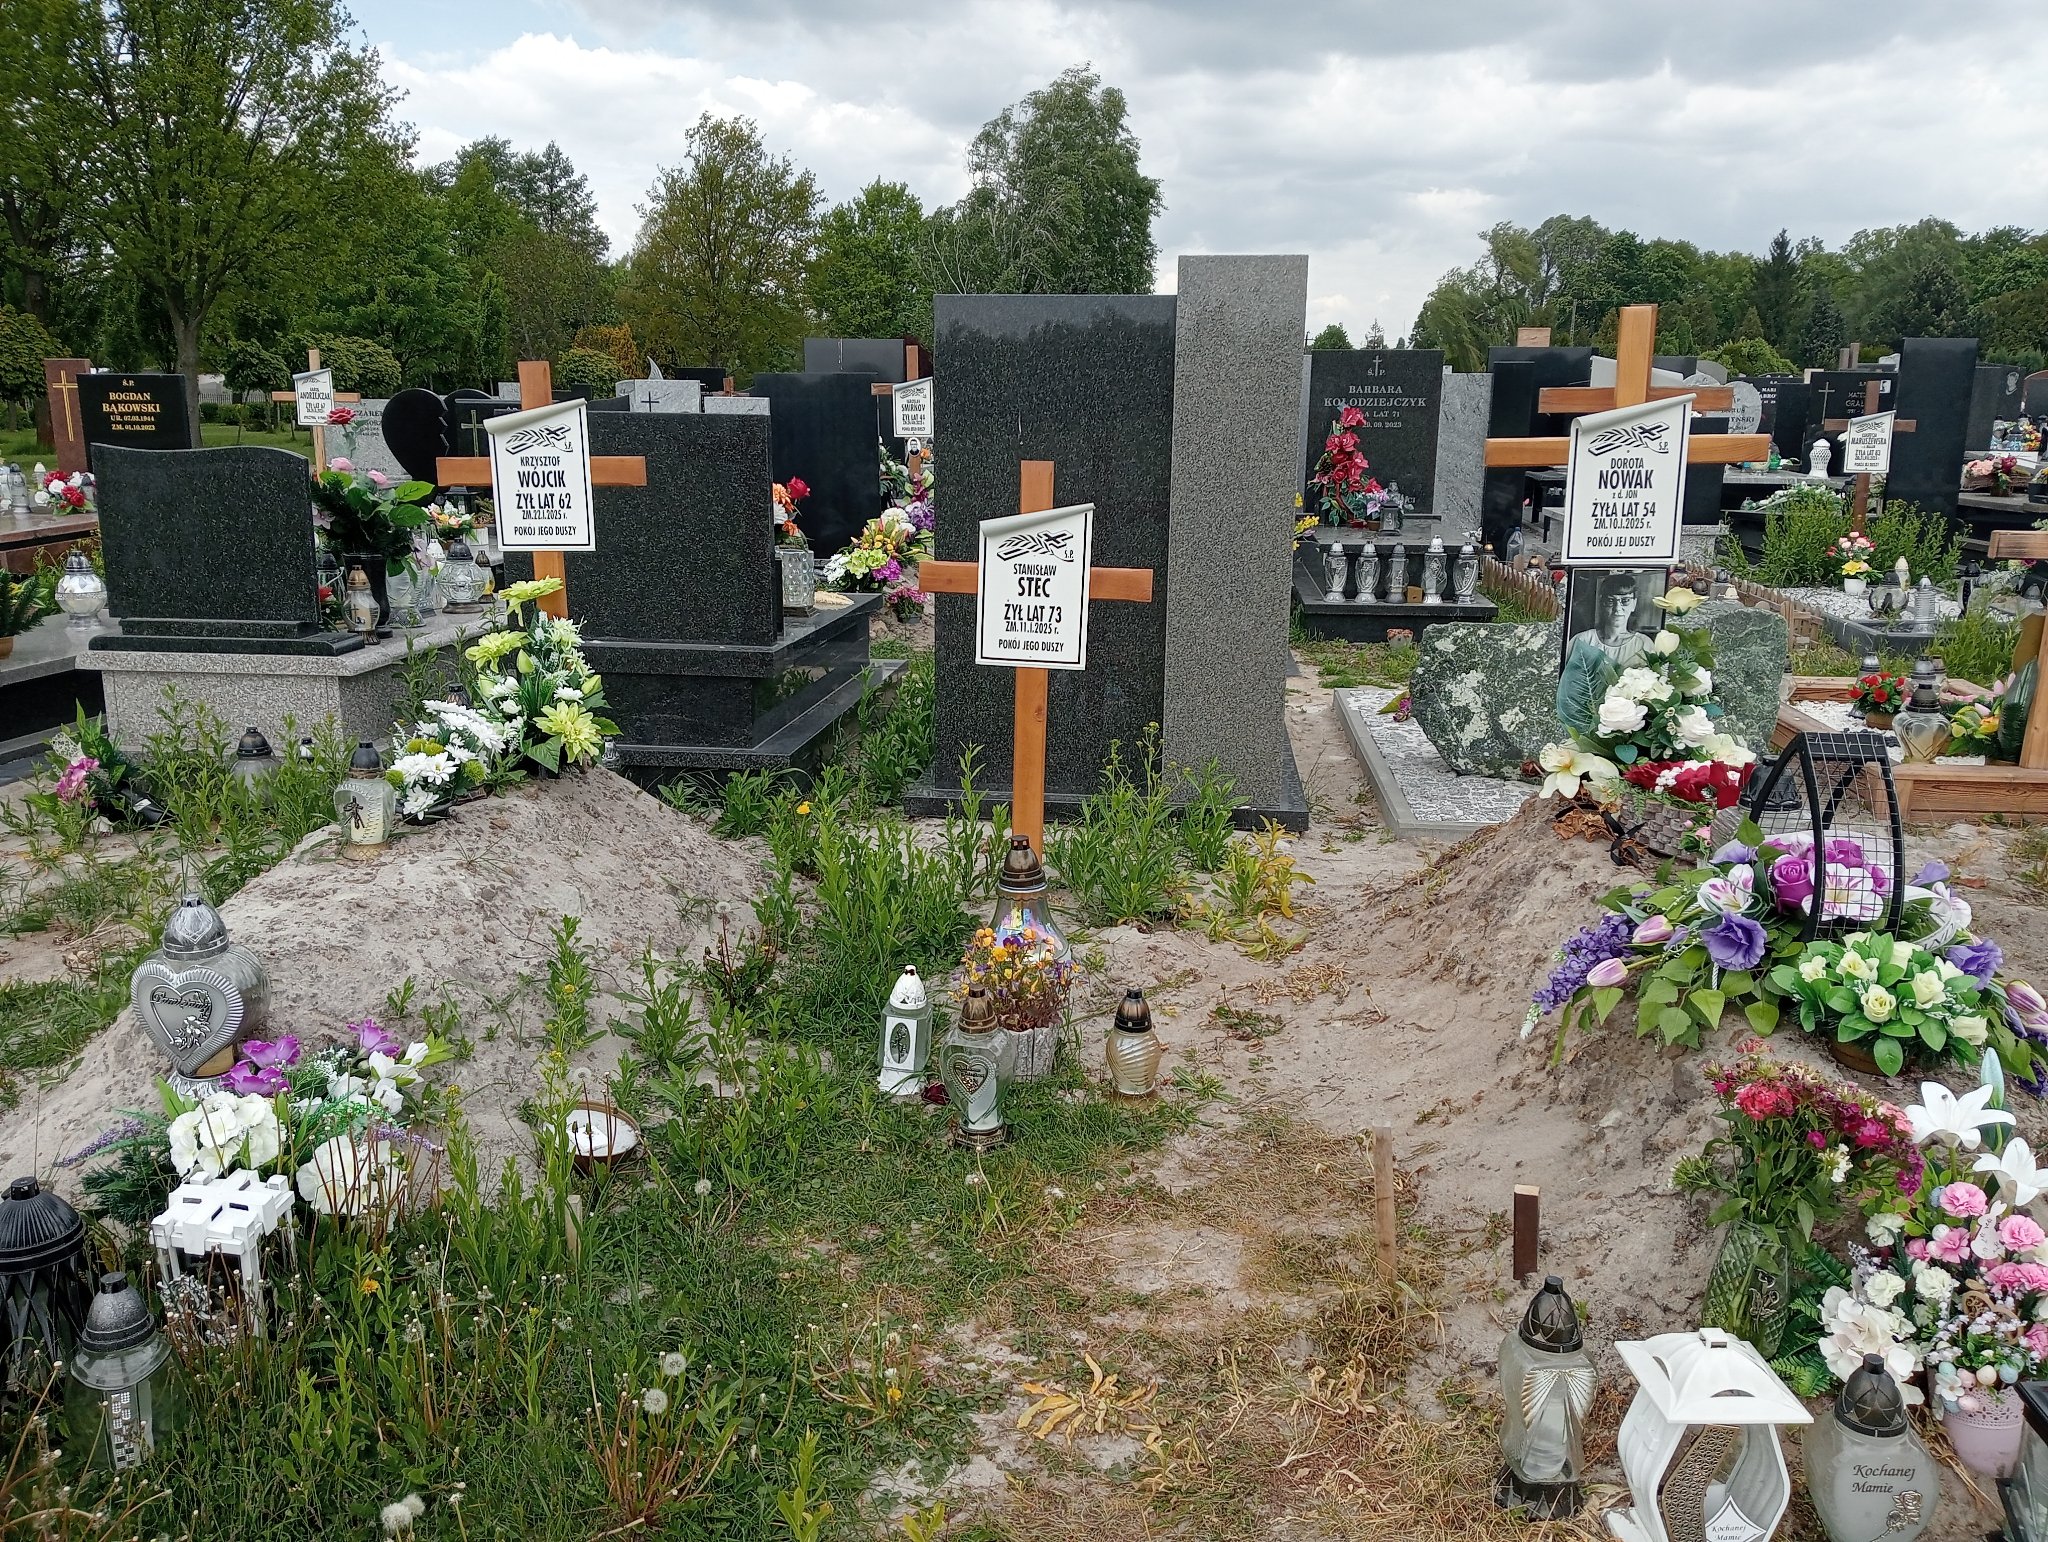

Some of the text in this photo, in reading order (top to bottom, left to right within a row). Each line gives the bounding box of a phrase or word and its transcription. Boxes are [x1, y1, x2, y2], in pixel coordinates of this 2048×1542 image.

[109, 391, 151, 401] BOGDAN
[1348, 385, 1403, 394] BARBARA
[102, 403, 160, 414] BĄKOWSKI
[1373, 410, 1390, 418] LAT
[520, 455, 561, 467] KRZYSZTOF
[1610, 457, 1645, 469] DOROTA
[517, 466, 566, 488] WÓJCIK
[1599, 469, 1654, 490] NOWAK
[516, 489, 572, 510] ŻYŁ LAT 62
[1625, 490, 1638, 499] JON
[1591, 498, 1656, 518] ŻYŁA LAT 54
[514, 523, 577, 536] POKÓJ JEGO DUSZY
[1586, 533, 1656, 548] POKÓJ JEJ DUSZY
[1013, 563, 1057, 576] STANISŁAW
[1017, 576, 1051, 598] STEC
[1003, 599, 1062, 624] ŻYŁ LAT 73
[998, 636, 1064, 653] POKÓJ JEGO DUSZY
[1853, 1463, 1916, 1482] Kochanej
[1851, 1481, 1894, 1493] Mamie
[1712, 1524, 1747, 1533] Kochanej
[1715, 1533, 1741, 1541] Mamie
